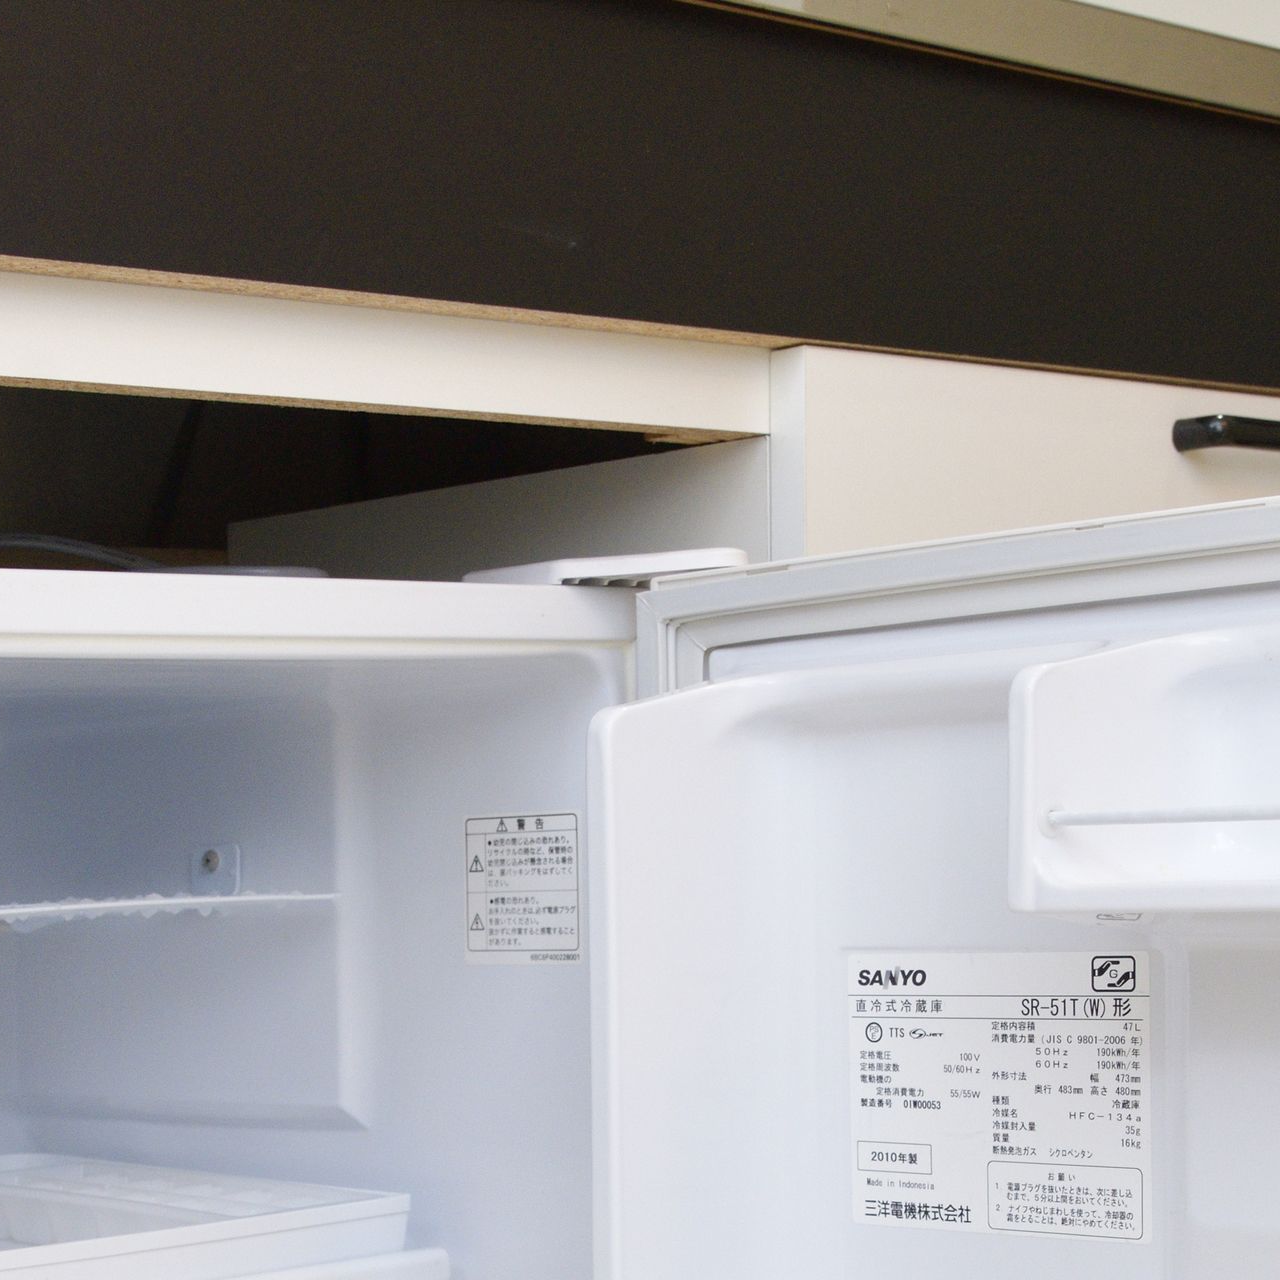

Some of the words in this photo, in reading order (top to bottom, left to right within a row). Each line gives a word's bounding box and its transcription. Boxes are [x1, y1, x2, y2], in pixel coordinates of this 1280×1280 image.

[858, 966, 926, 989] SANYO
[1109, 970, 1118, 978] G
[856, 999, 943, 1012] 直冷式冷蔵庫
[1021, 998, 1106, 1017] SR-51T(W)
[1113, 998, 1131, 1016] 形
[890, 1028, 904, 1038] TTS
[871, 1152, 917, 1164] 2010年製
[865, 1200, 971, 1223] 三洋電機株式会社
